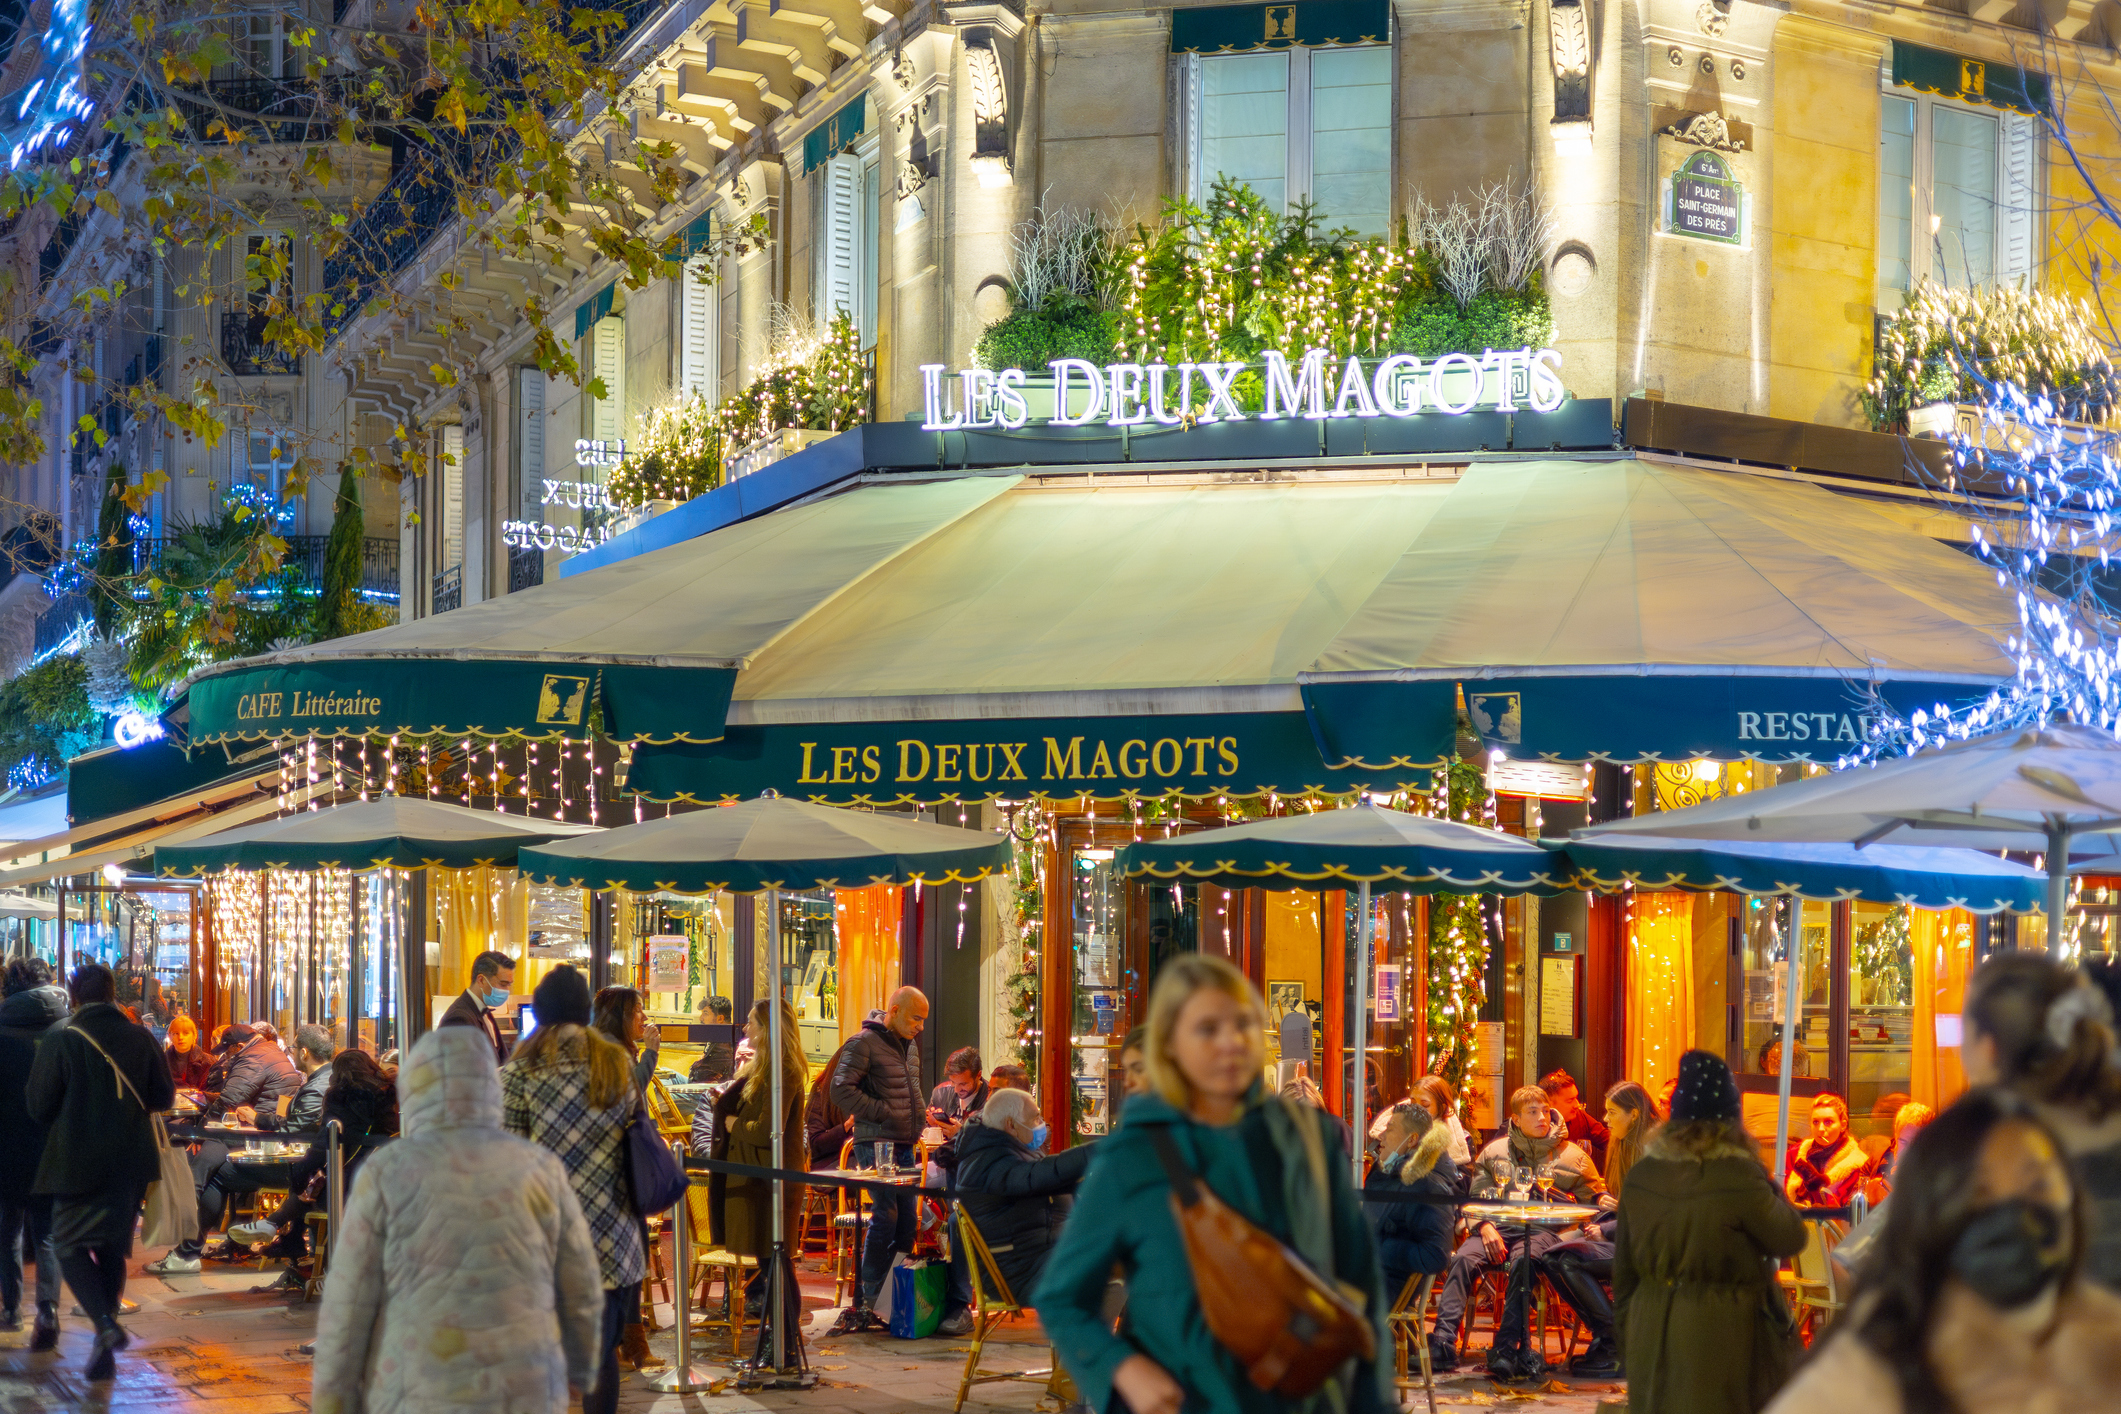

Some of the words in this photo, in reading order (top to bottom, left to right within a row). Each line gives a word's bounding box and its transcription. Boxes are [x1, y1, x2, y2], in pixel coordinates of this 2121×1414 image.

[1695, 186, 1721, 200] PLACE
[1678, 198, 1736, 218] SAINT-GERMAIN
[1687, 215, 1703, 227] DES
[1705, 217, 1727, 231] PRÉS
[919, 363, 1028, 431] LES
[1048, 357, 1247, 428] DEUX
[1259, 345, 1565, 419] MAGOTS
[291, 689, 382, 717] Littéraire
[797, 741, 882, 784] LES
[894, 739, 1029, 783] DEUX
[1041, 735, 1240, 780] MAGOTS
